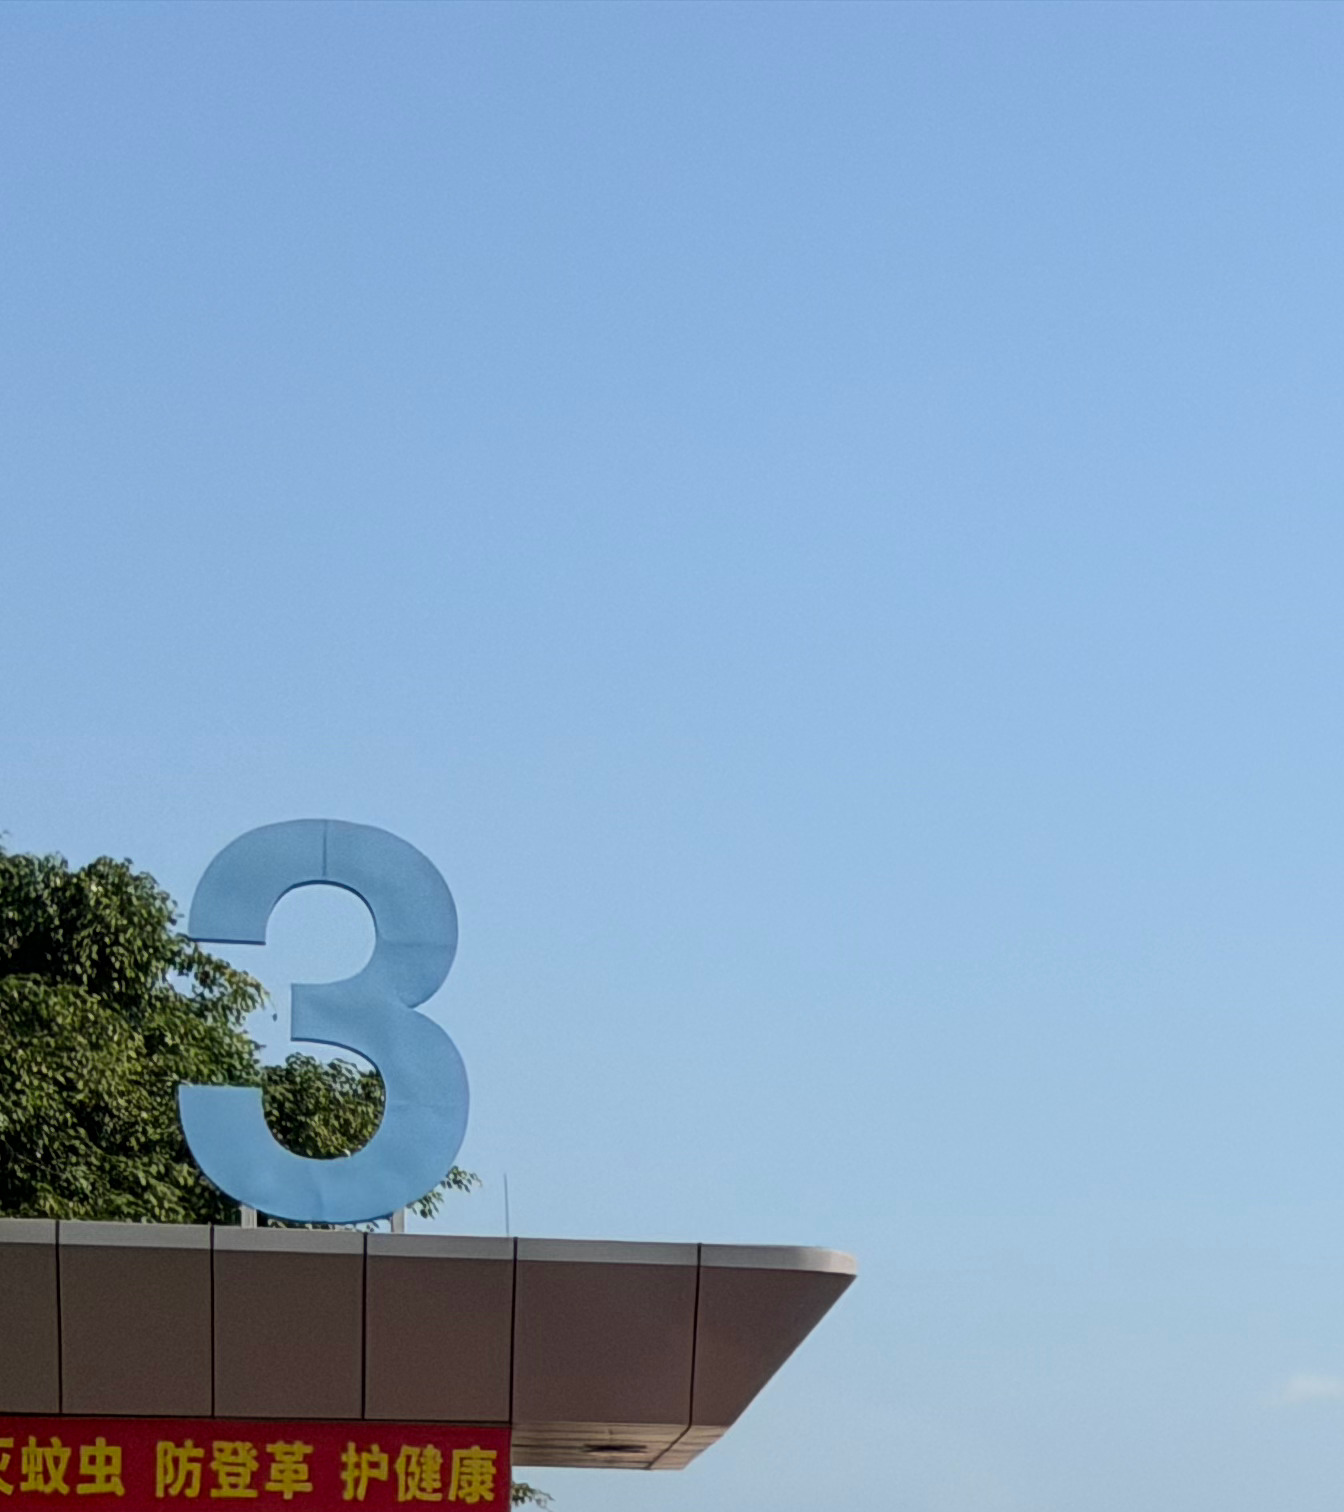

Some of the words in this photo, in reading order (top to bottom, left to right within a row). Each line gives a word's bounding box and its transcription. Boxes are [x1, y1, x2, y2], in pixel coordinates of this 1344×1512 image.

[178, 819, 470, 1223] 3
[0, 1436, 125, 1497] 蚊虫
[155, 1438, 314, 1500] 防登革
[340, 1441, 498, 1503] 护健康
